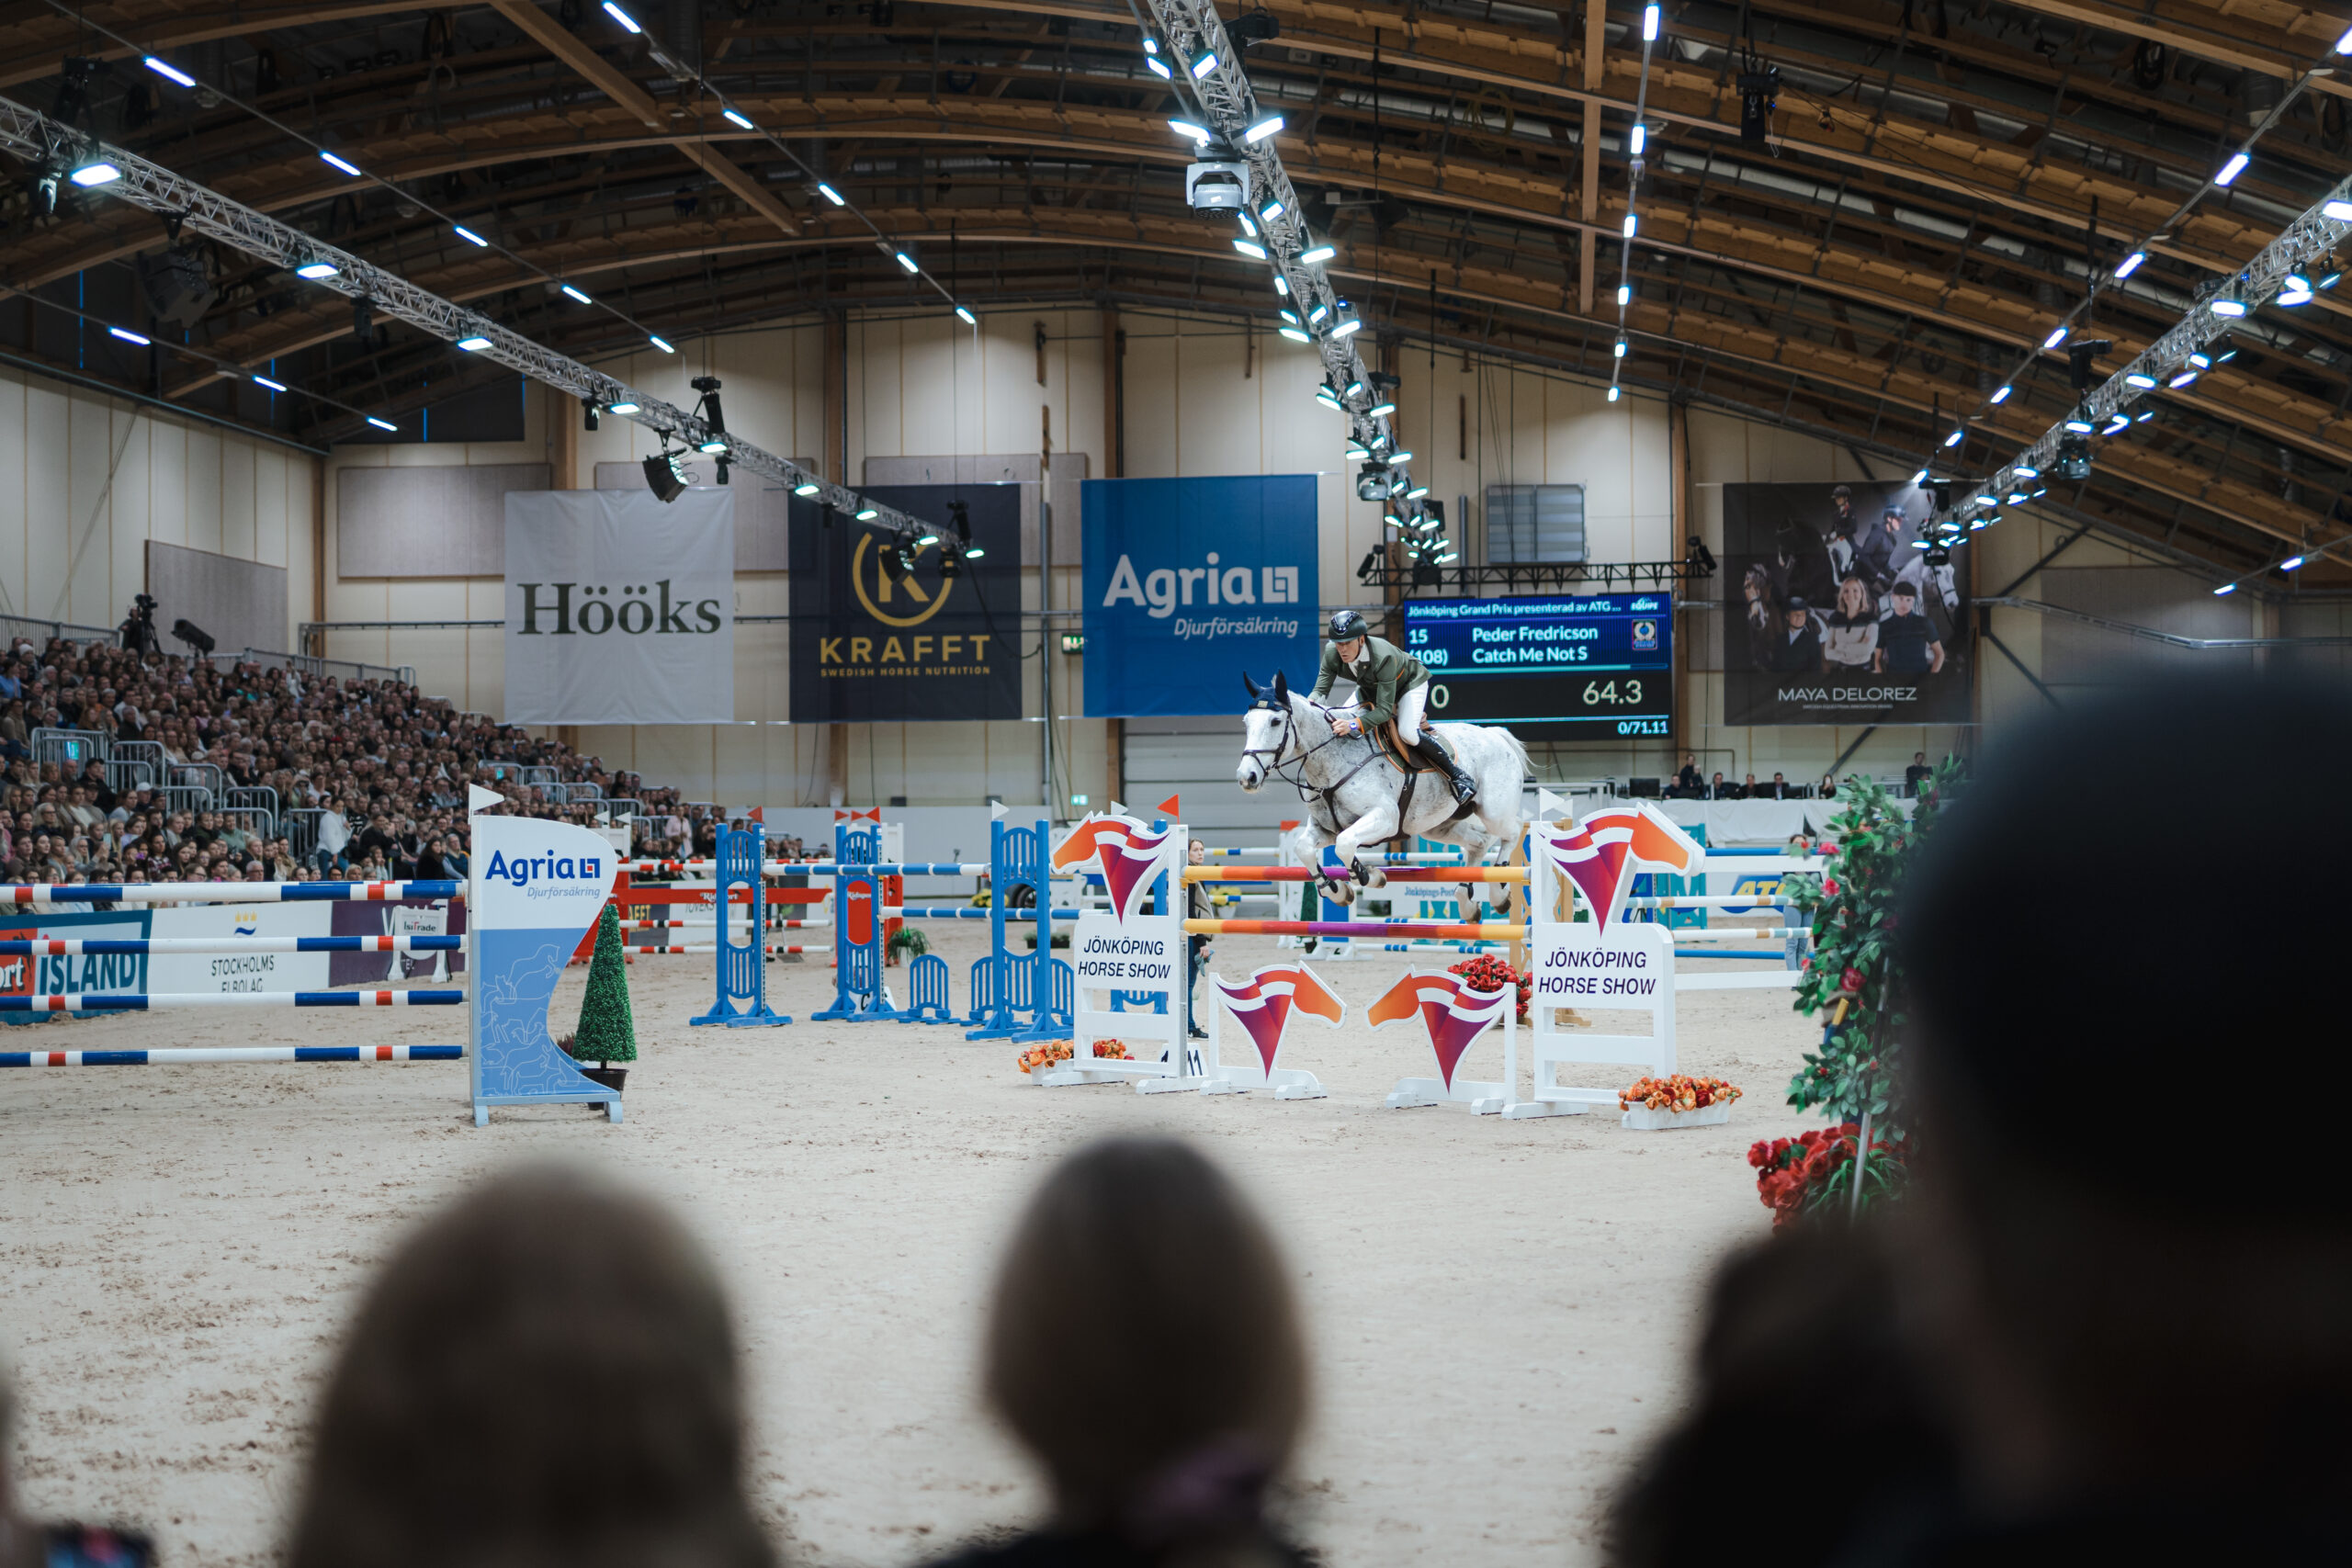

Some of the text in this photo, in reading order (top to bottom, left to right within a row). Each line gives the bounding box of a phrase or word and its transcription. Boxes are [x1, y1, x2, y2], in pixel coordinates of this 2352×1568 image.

[1102, 551, 1255, 618] Agria
[516, 578, 722, 636] Hööks
[1408, 605, 1459, 618] Jönköping
[1459, 604, 1491, 615] Grand
[1492, 604, 1512, 615] Prix
[1513, 602, 1574, 616] presenterad
[1576, 603, 1588, 612] av
[1589, 601, 1611, 612] ATG
[1173, 615, 1299, 639] Djurförsäkring
[1408, 625, 1599, 645] 15 Peder Fredricson
[820, 635, 991, 663] KRAFFT
[1472, 648, 1517, 663] Catch
[1519, 647, 1544, 662] Me
[1546, 646, 1576, 661] Not
[1577, 646, 1588, 660] S
[820, 666, 990, 678] SWEDISH HORSE NUTRITION
[1582, 679, 1643, 705] 64.3
[1778, 686, 1917, 702] MAYA DELOREZ
[1617, 721, 1668, 735] 0/71.11
[485, 849, 575, 886] Agria
[527, 886, 601, 900] Djurförsäkring
[404, 920, 436, 931] IsiTrade
[1083, 934, 1164, 956] JÖNKÖPING
[211, 954, 275, 976] STOCKHOLMS
[1544, 946, 1647, 969] JÖNKÖPING
[1078, 961, 1170, 979] HORSE SHOW
[1539, 976, 1657, 996] HORSE SHOW
